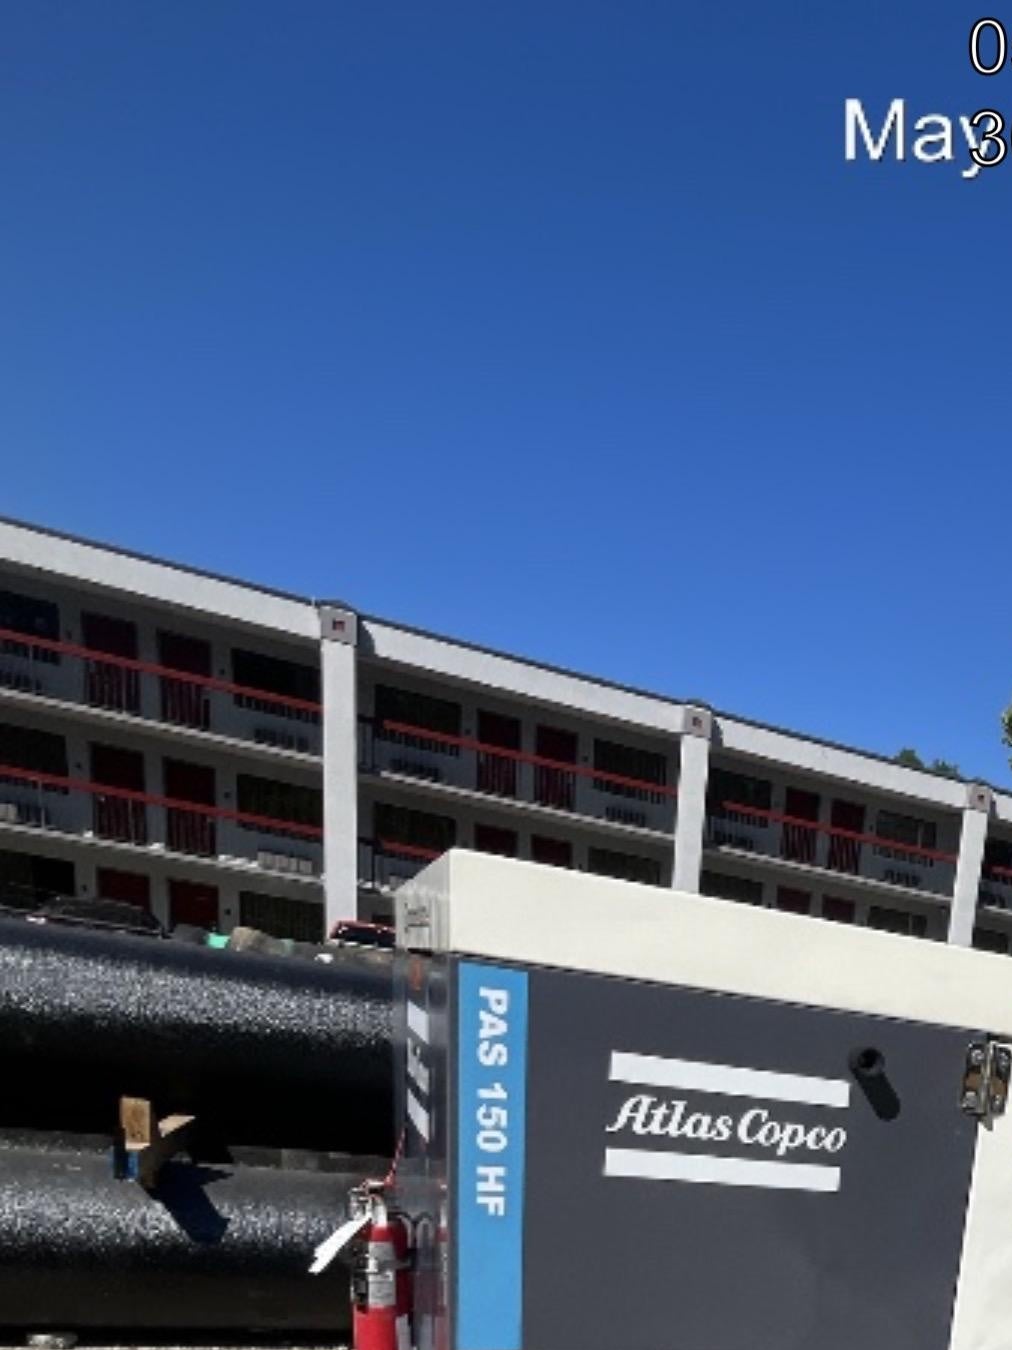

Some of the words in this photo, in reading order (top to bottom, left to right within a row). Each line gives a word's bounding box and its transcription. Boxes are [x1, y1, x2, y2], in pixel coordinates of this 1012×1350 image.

[478, 985, 509, 1068] PAS
[475, 1082, 508, 1153] 150
[604, 1094, 734, 1141] Atlas
[736, 1108, 848, 1157] Copco
[475, 1165, 506, 1217] HF
